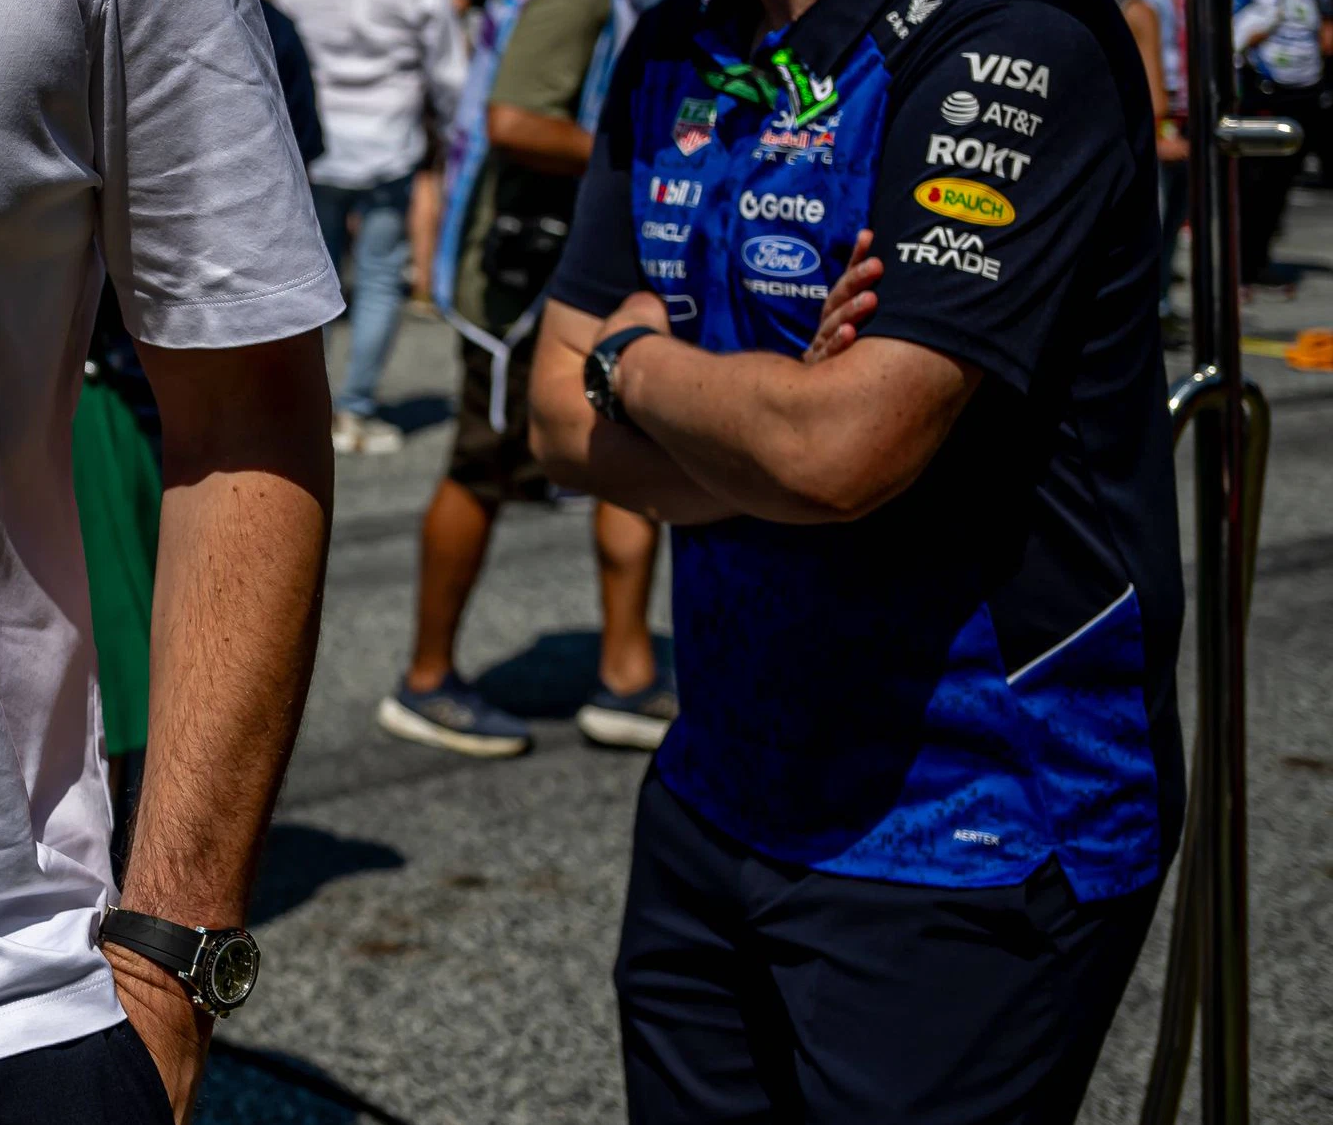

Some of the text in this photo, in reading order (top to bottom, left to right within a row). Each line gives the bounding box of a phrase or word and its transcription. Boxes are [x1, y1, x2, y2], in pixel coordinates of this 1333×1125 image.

[960, 51, 1051, 100] VISA
[981, 101, 1043, 137] AT&T
[925, 133, 1031, 182] ROKT
[944, 188, 1004, 219] RAUCH
[753, 239, 807, 271] Ford
[921, 225, 985, 253] AVA
[895, 242, 1002, 282] TRADE
